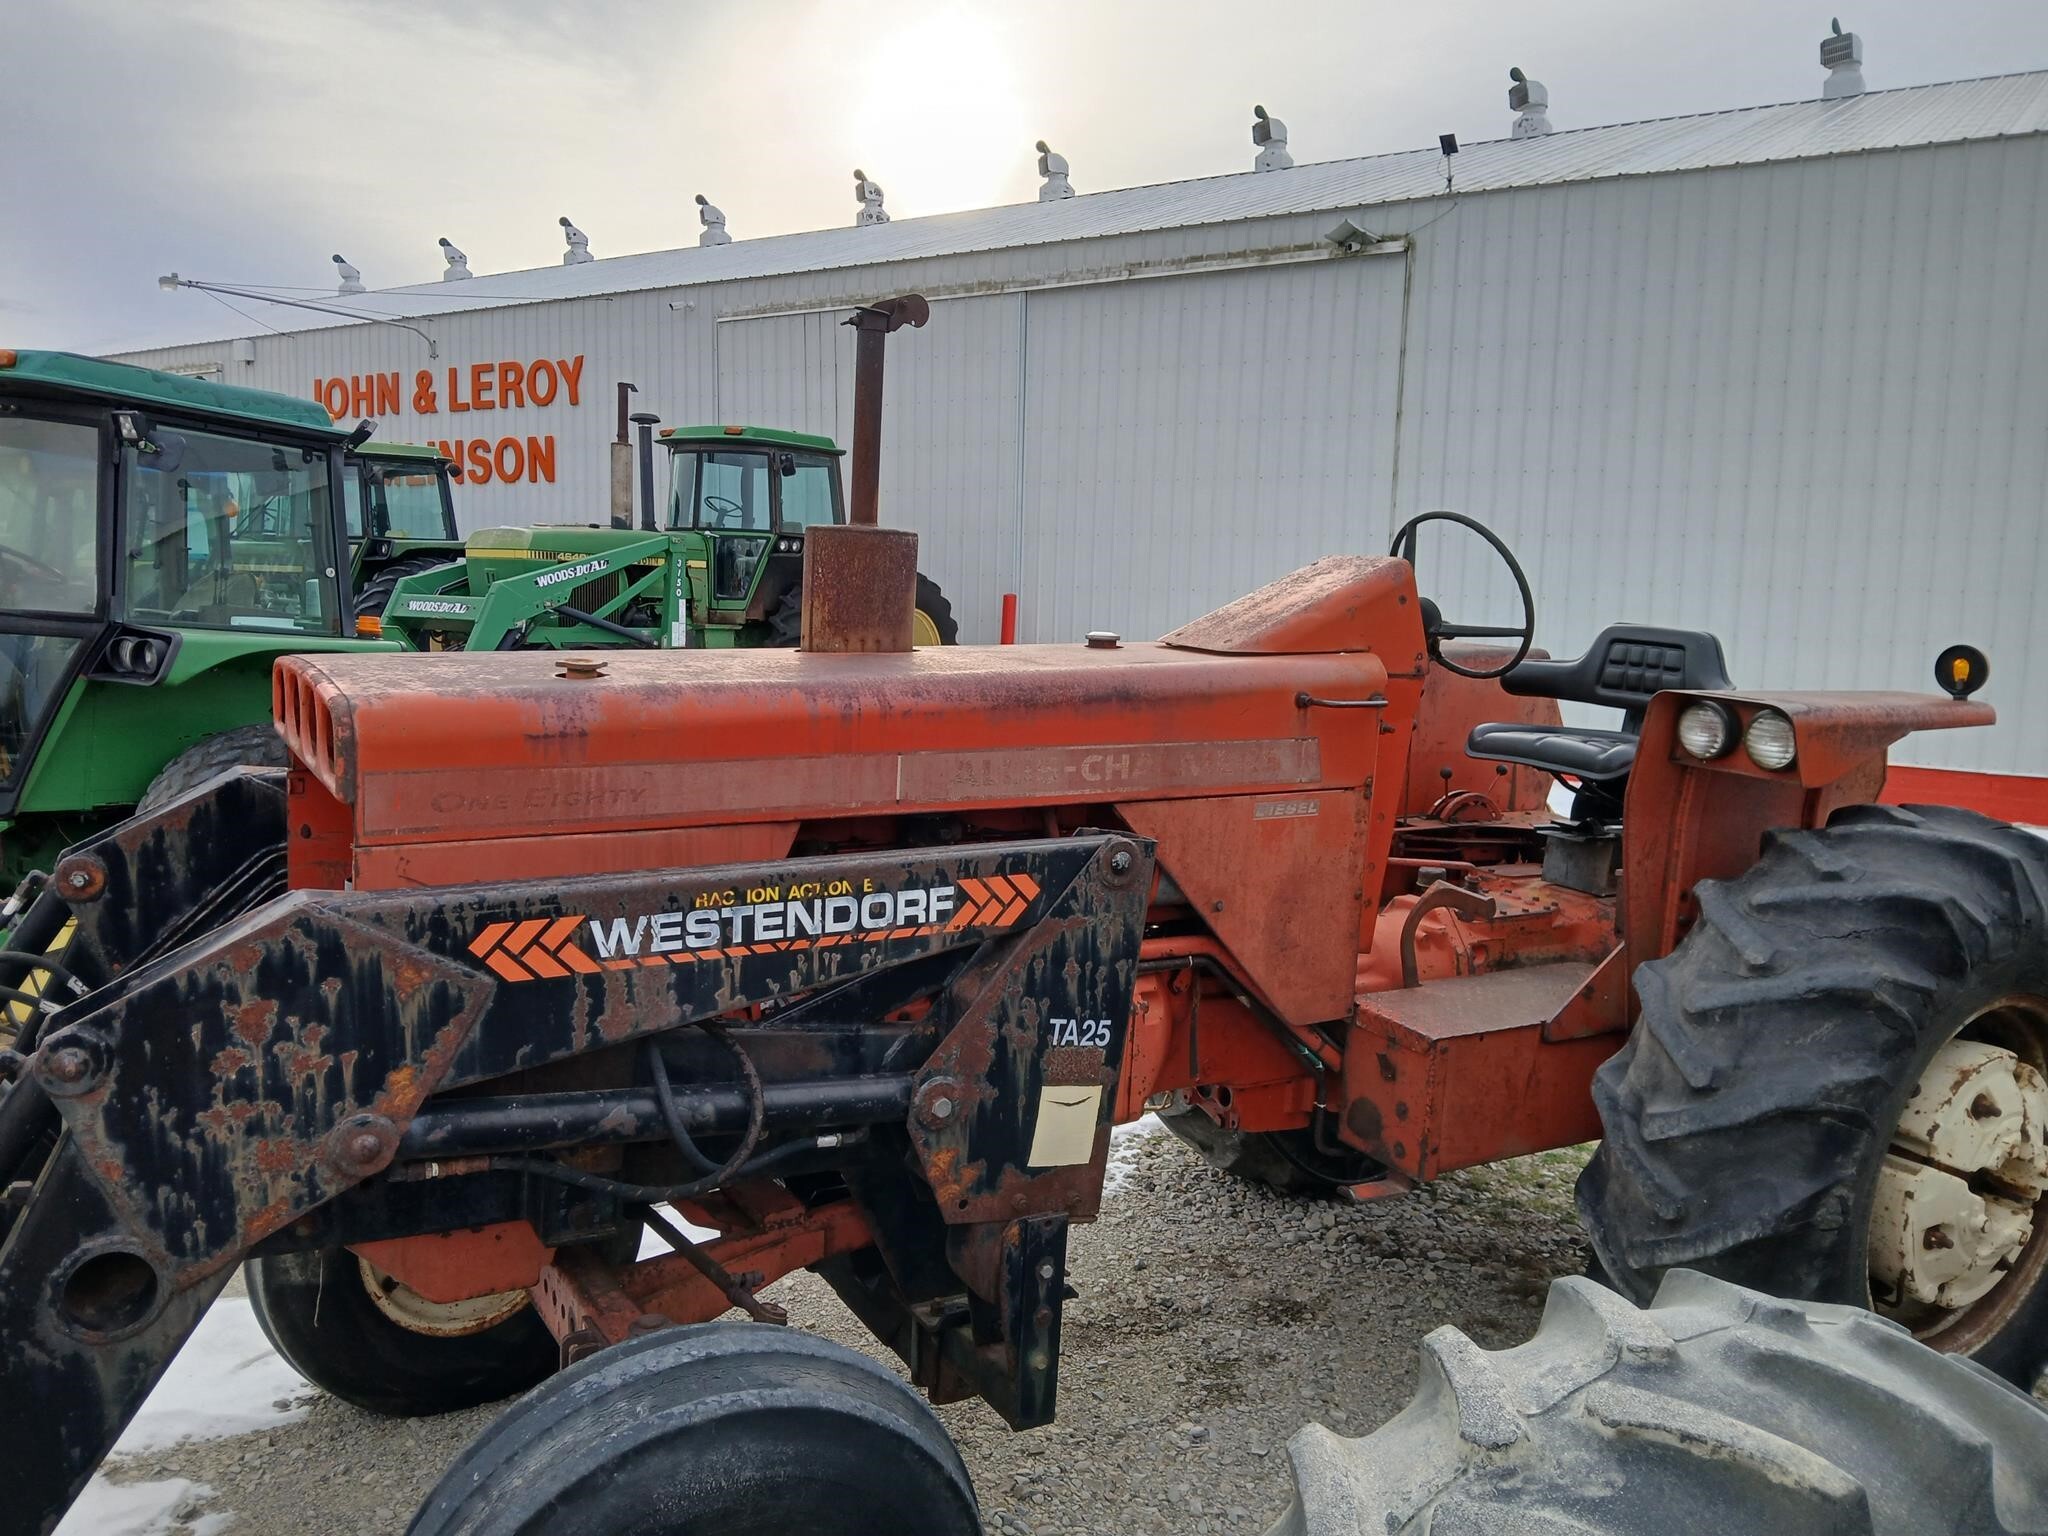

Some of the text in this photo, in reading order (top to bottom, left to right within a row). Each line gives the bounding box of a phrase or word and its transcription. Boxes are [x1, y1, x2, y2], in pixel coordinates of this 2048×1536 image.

[314, 355, 584, 420] JOHN & LEROY
[589, 886, 954, 958] WESTENDORF
[1050, 1018, 1112, 1047] TA25
